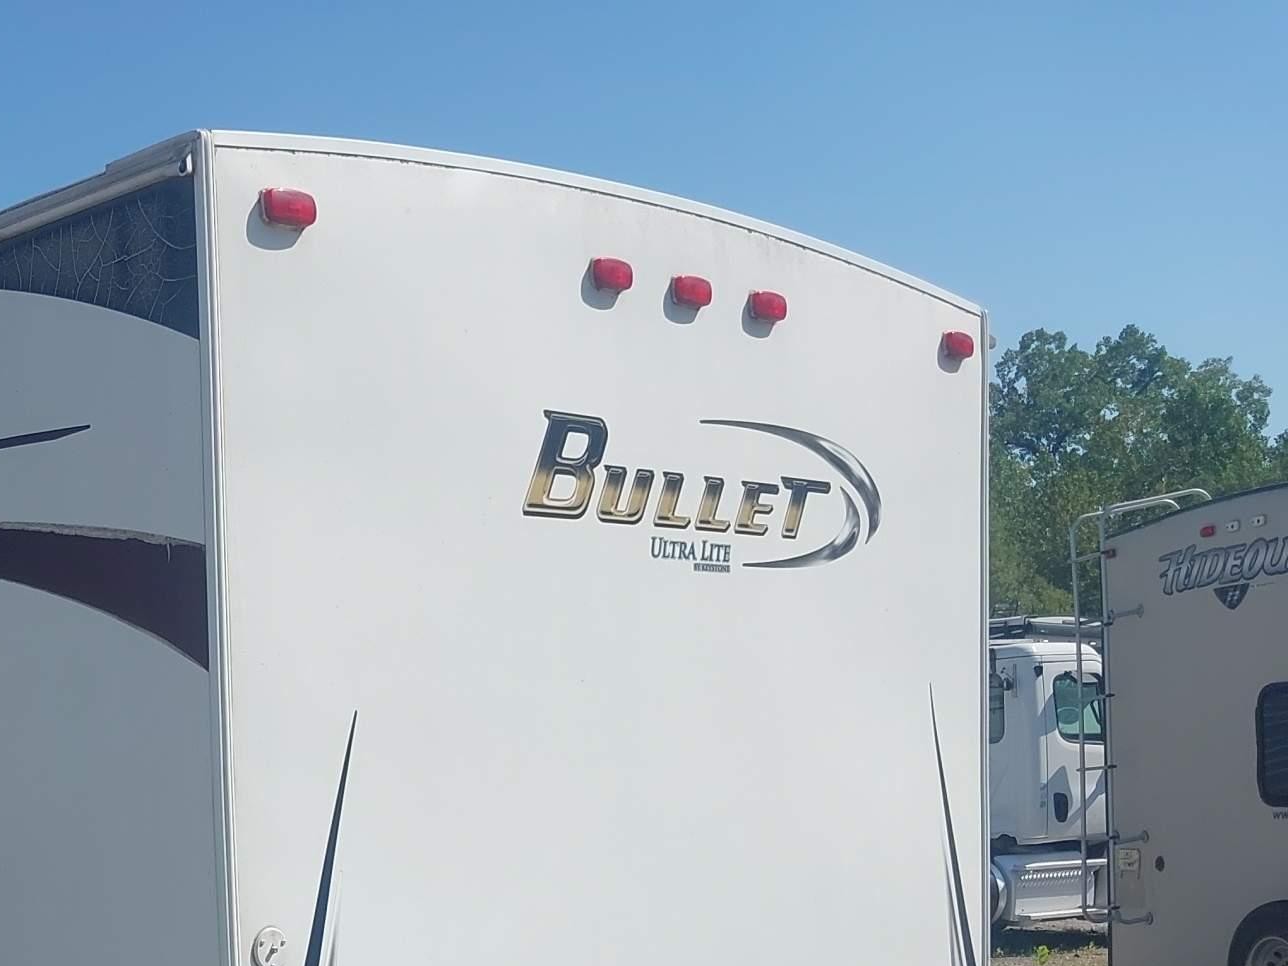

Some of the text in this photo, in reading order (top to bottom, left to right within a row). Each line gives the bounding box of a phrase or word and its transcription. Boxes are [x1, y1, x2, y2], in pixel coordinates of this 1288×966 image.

[522, 409, 832, 539] BULLET
[651, 536, 731, 563] ULTRA LITE
